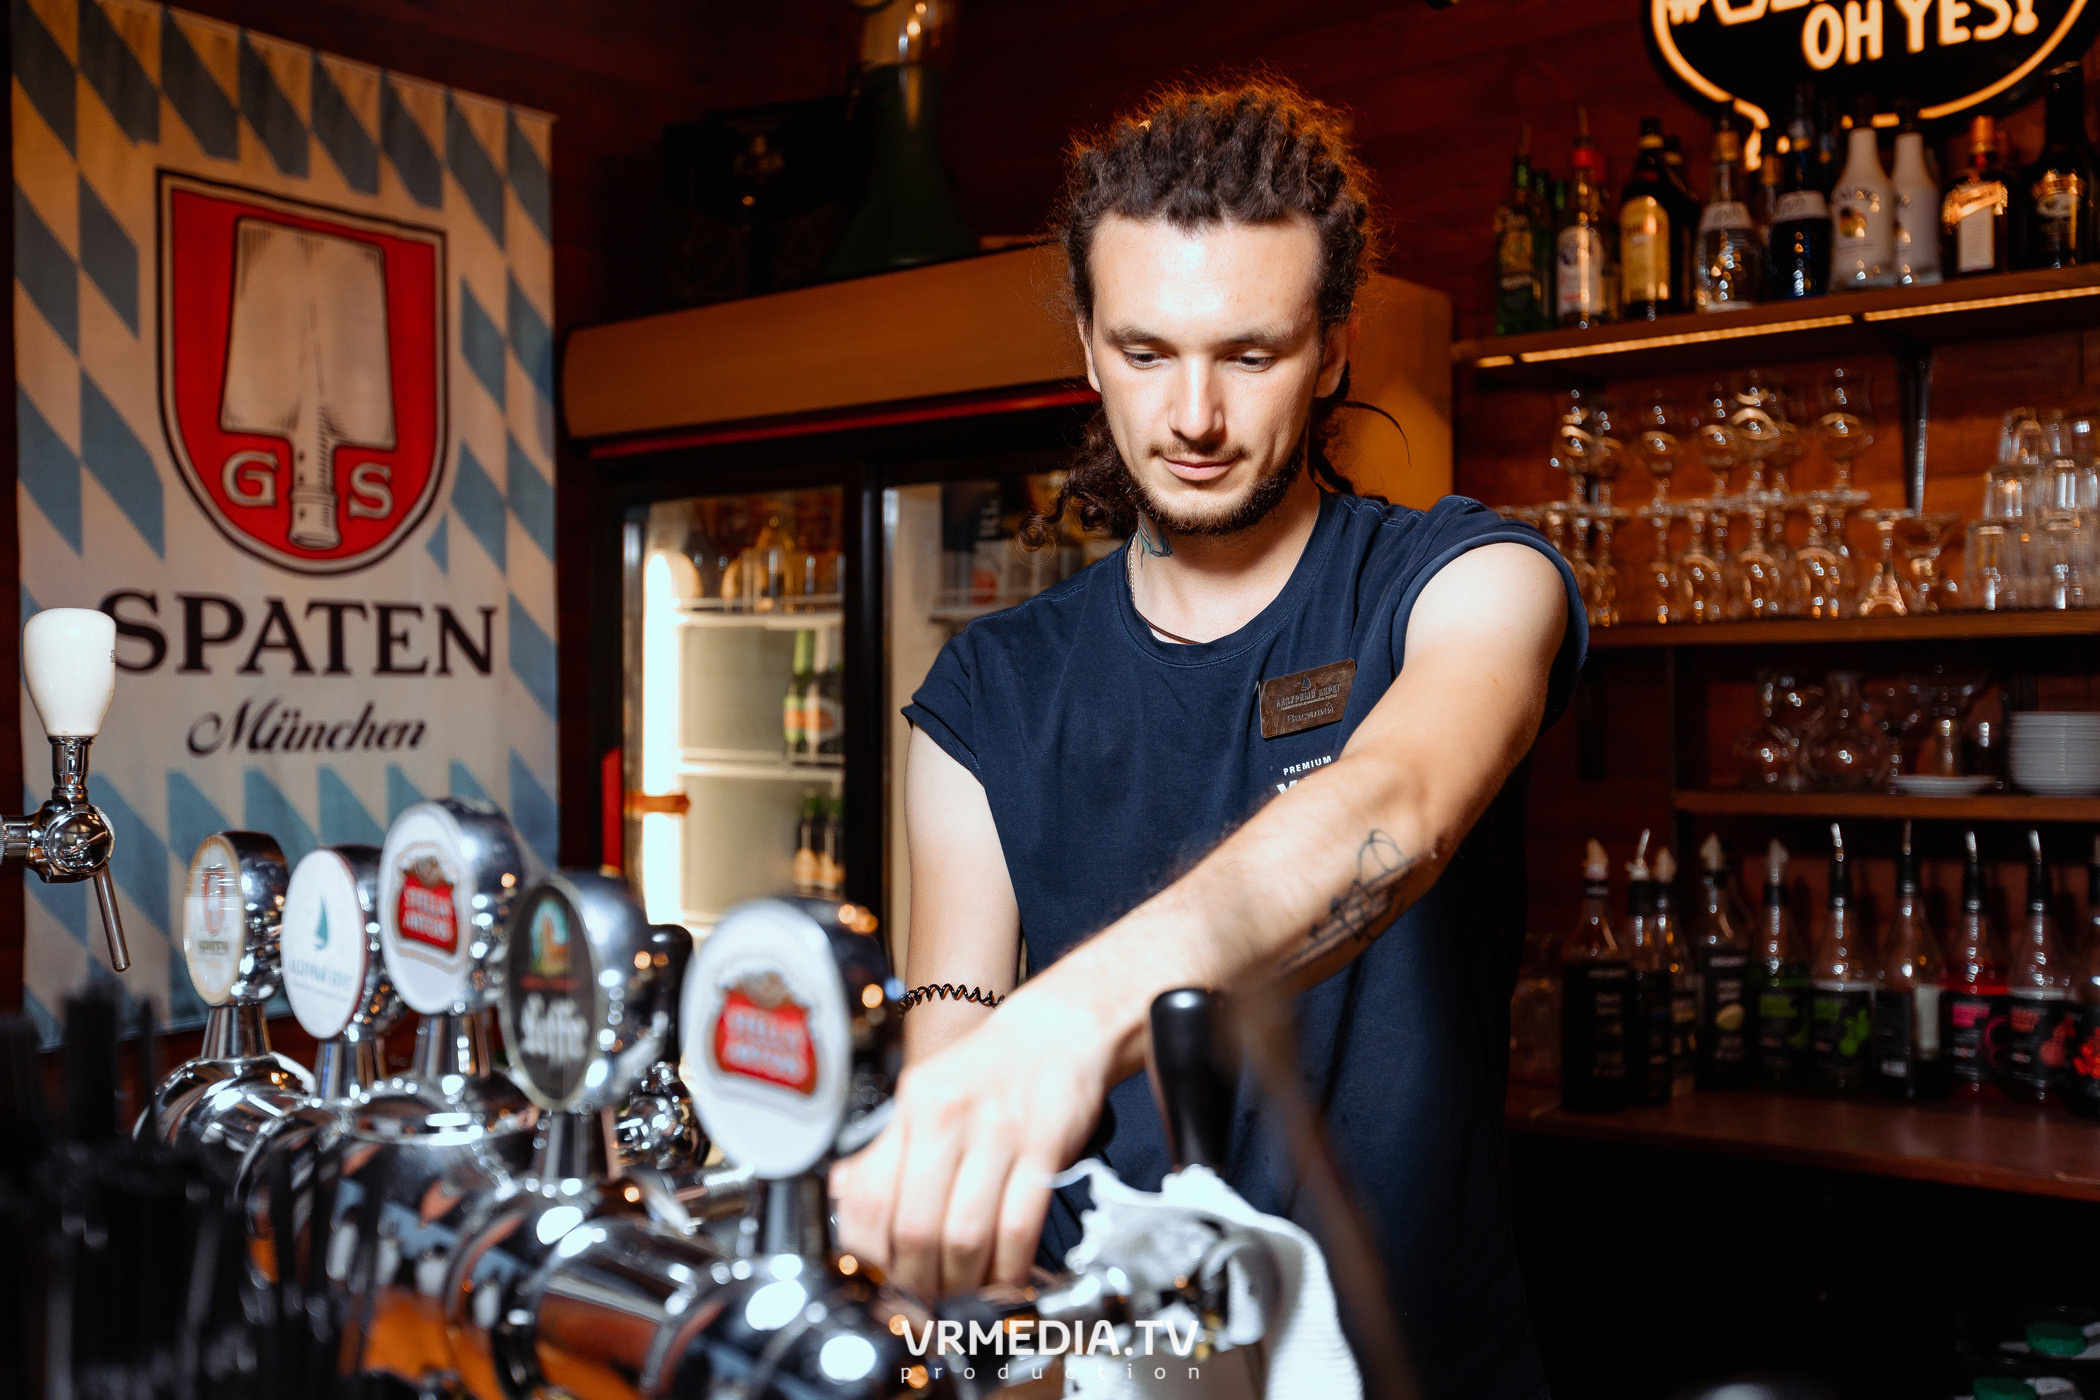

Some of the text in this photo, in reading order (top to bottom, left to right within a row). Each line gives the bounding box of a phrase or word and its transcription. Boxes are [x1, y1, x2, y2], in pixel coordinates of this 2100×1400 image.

[1801, 2, 1885, 71] OH
[222, 451, 395, 520] G S
[99, 588, 498, 677] SPATEN
[186, 697, 430, 757] München
[1282, 755, 1332, 776] PREMIUM
